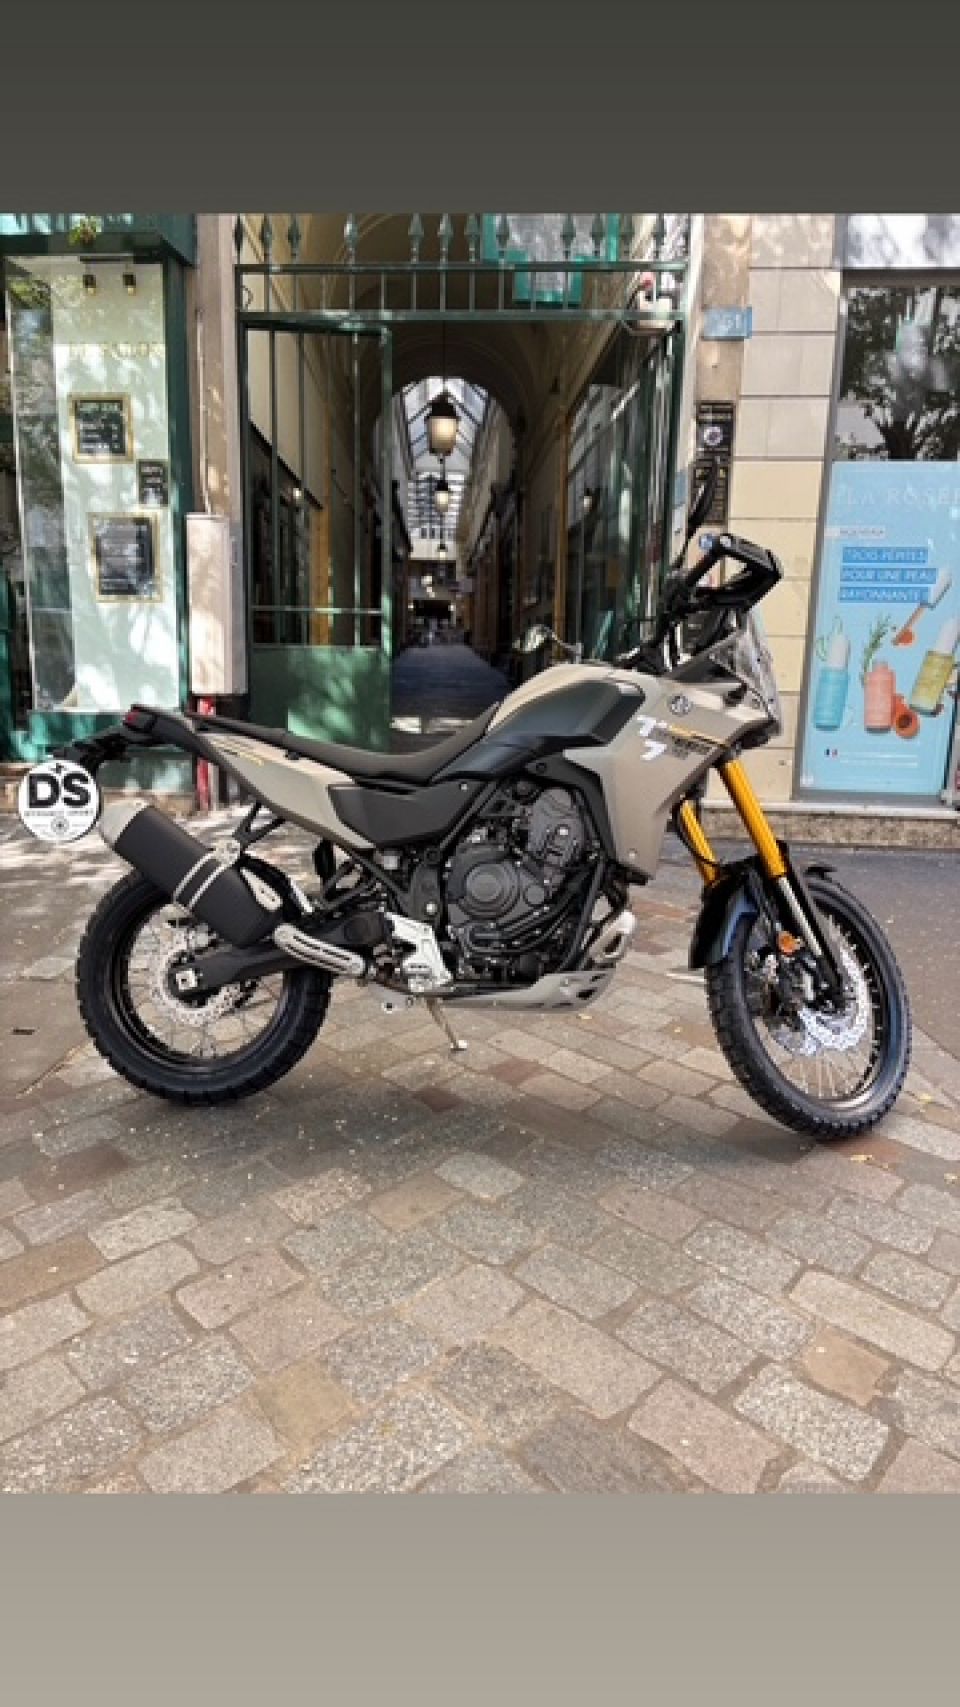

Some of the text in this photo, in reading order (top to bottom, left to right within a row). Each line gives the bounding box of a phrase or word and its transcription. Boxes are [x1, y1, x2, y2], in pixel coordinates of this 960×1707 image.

[841, 569, 873, 580] POUR
[876, 569, 899, 580] UNE
[28, 772, 91, 809] DS
